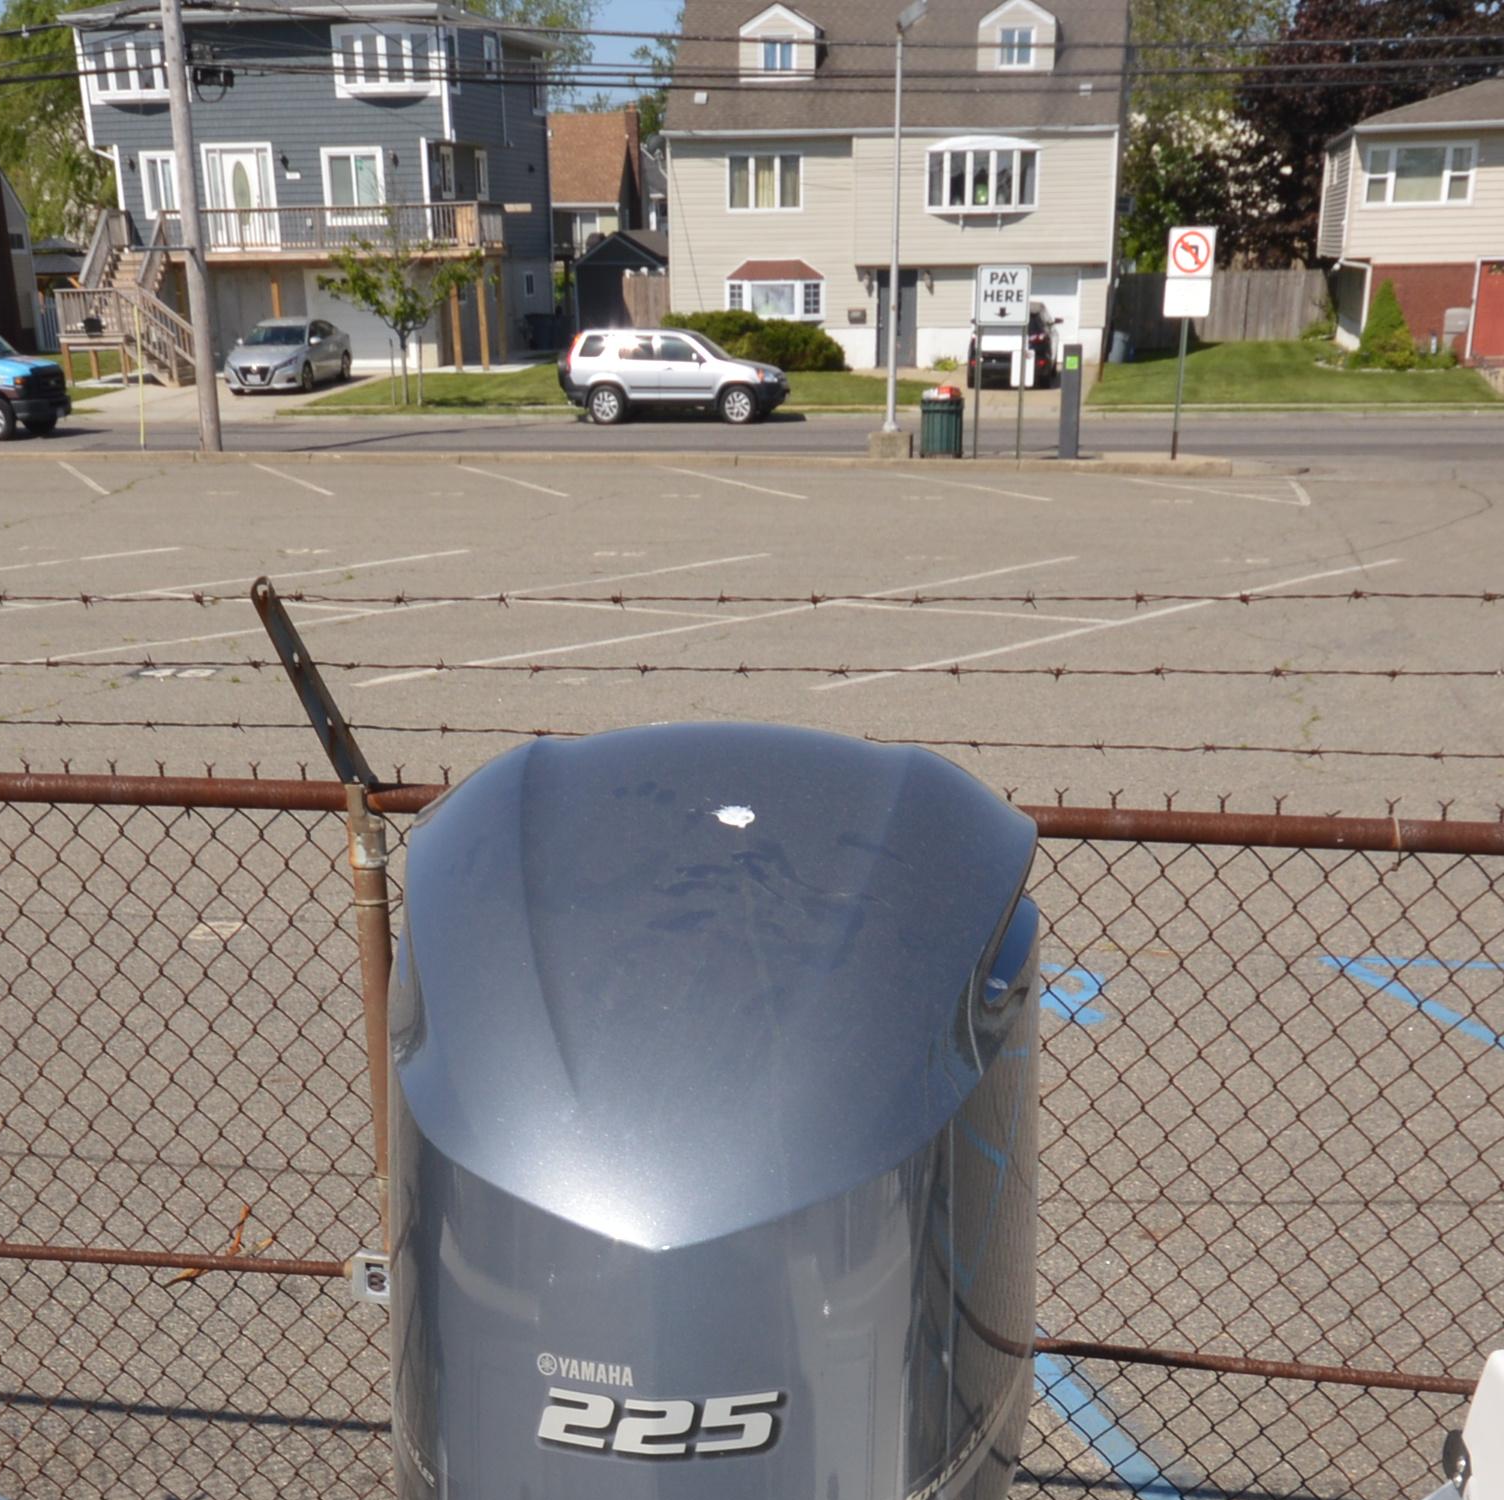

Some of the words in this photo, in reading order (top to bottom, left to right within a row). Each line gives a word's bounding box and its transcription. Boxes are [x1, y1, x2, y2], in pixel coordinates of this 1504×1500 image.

[989, 271, 1019, 285] PAY
[983, 289, 1024, 303] HERE
[559, 1357, 634, 1387] YAMAHA
[537, 1387, 779, 1455] 225
